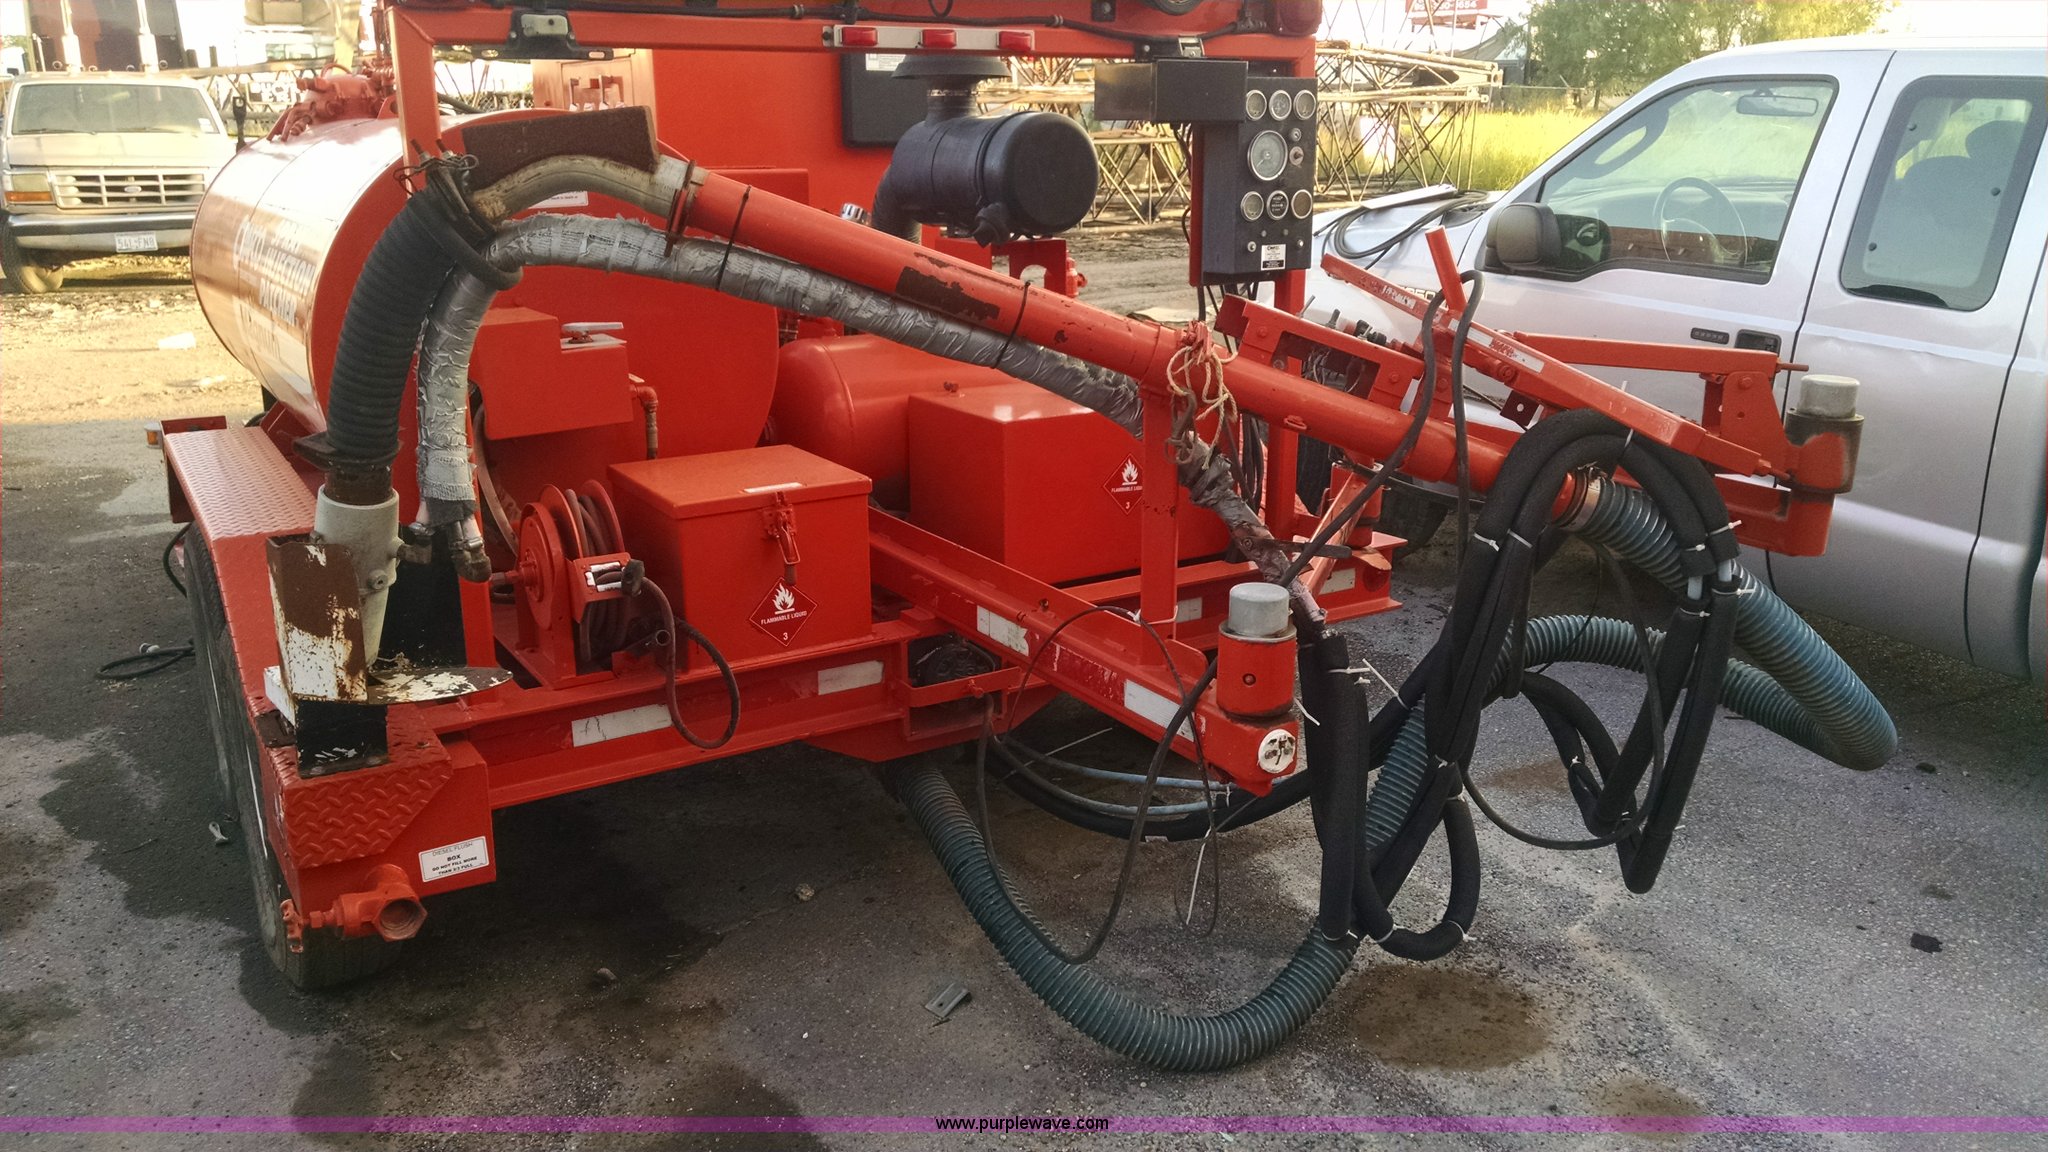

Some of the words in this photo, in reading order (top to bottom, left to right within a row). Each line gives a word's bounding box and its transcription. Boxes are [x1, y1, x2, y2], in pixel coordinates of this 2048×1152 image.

[265, 247, 317, 296] INJECTION
[259, 277, 298, 327] PATCHER
[1125, 501, 1130, 509] 3
[761, 614, 790, 625] FLAMMABLE
[791, 610, 807, 619] LIQUID
[783, 632, 788, 640] 3
